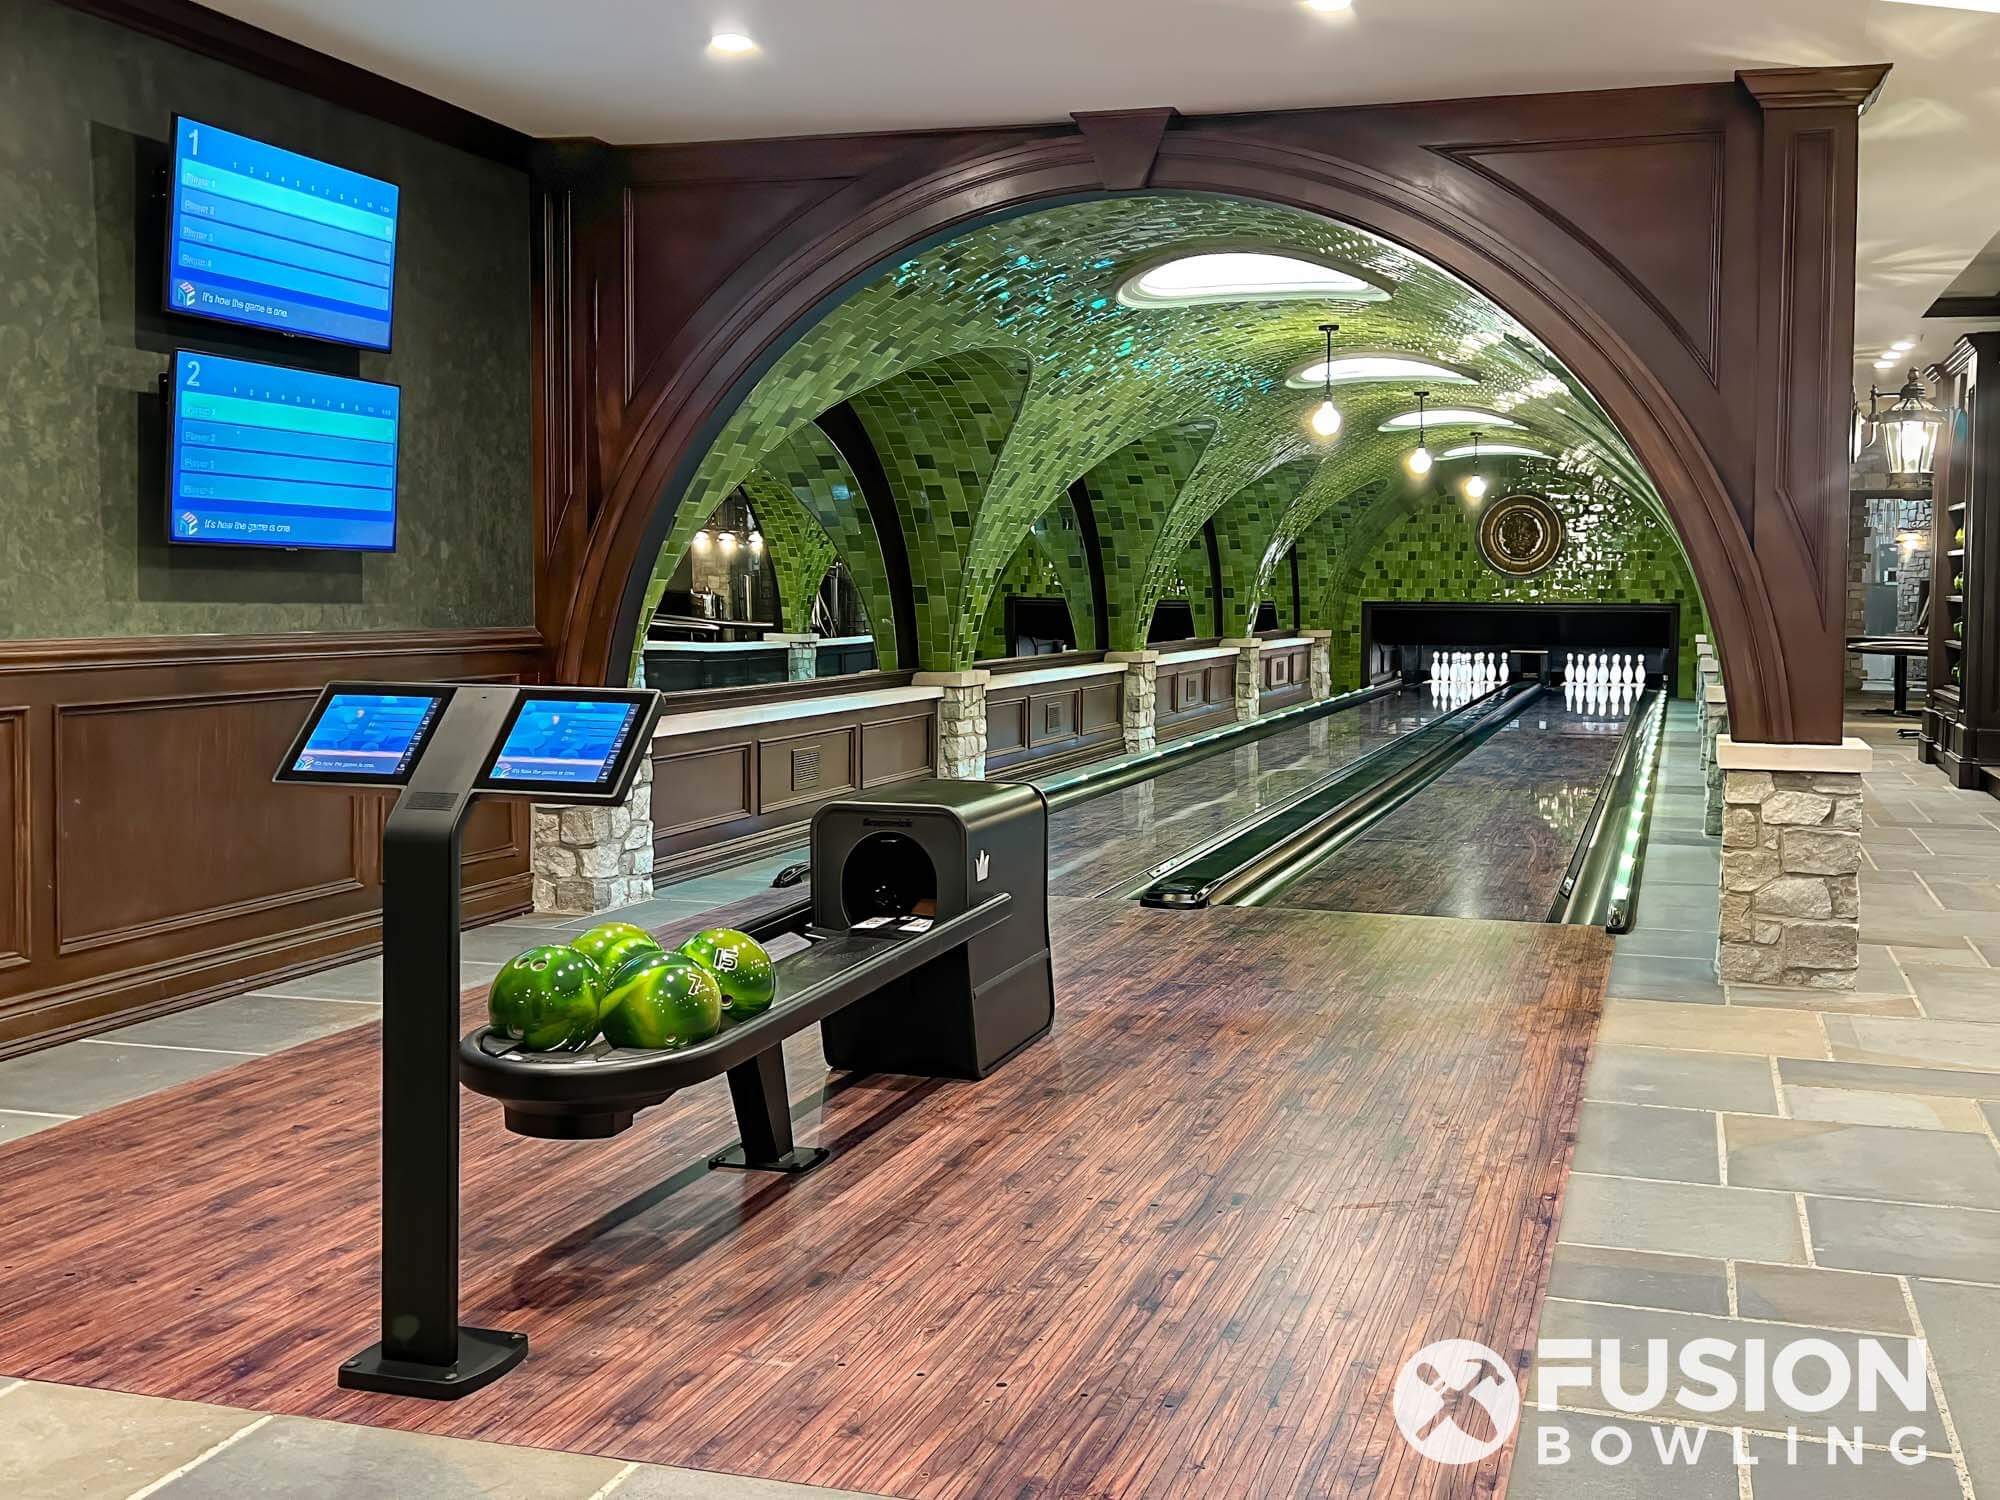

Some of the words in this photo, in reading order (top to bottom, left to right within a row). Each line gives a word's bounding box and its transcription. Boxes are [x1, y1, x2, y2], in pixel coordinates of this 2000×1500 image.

[188, 128, 199, 156] 1
[187, 360, 200, 387] 2
[713, 947, 739, 973] 15
[688, 973, 702, 996] 7
